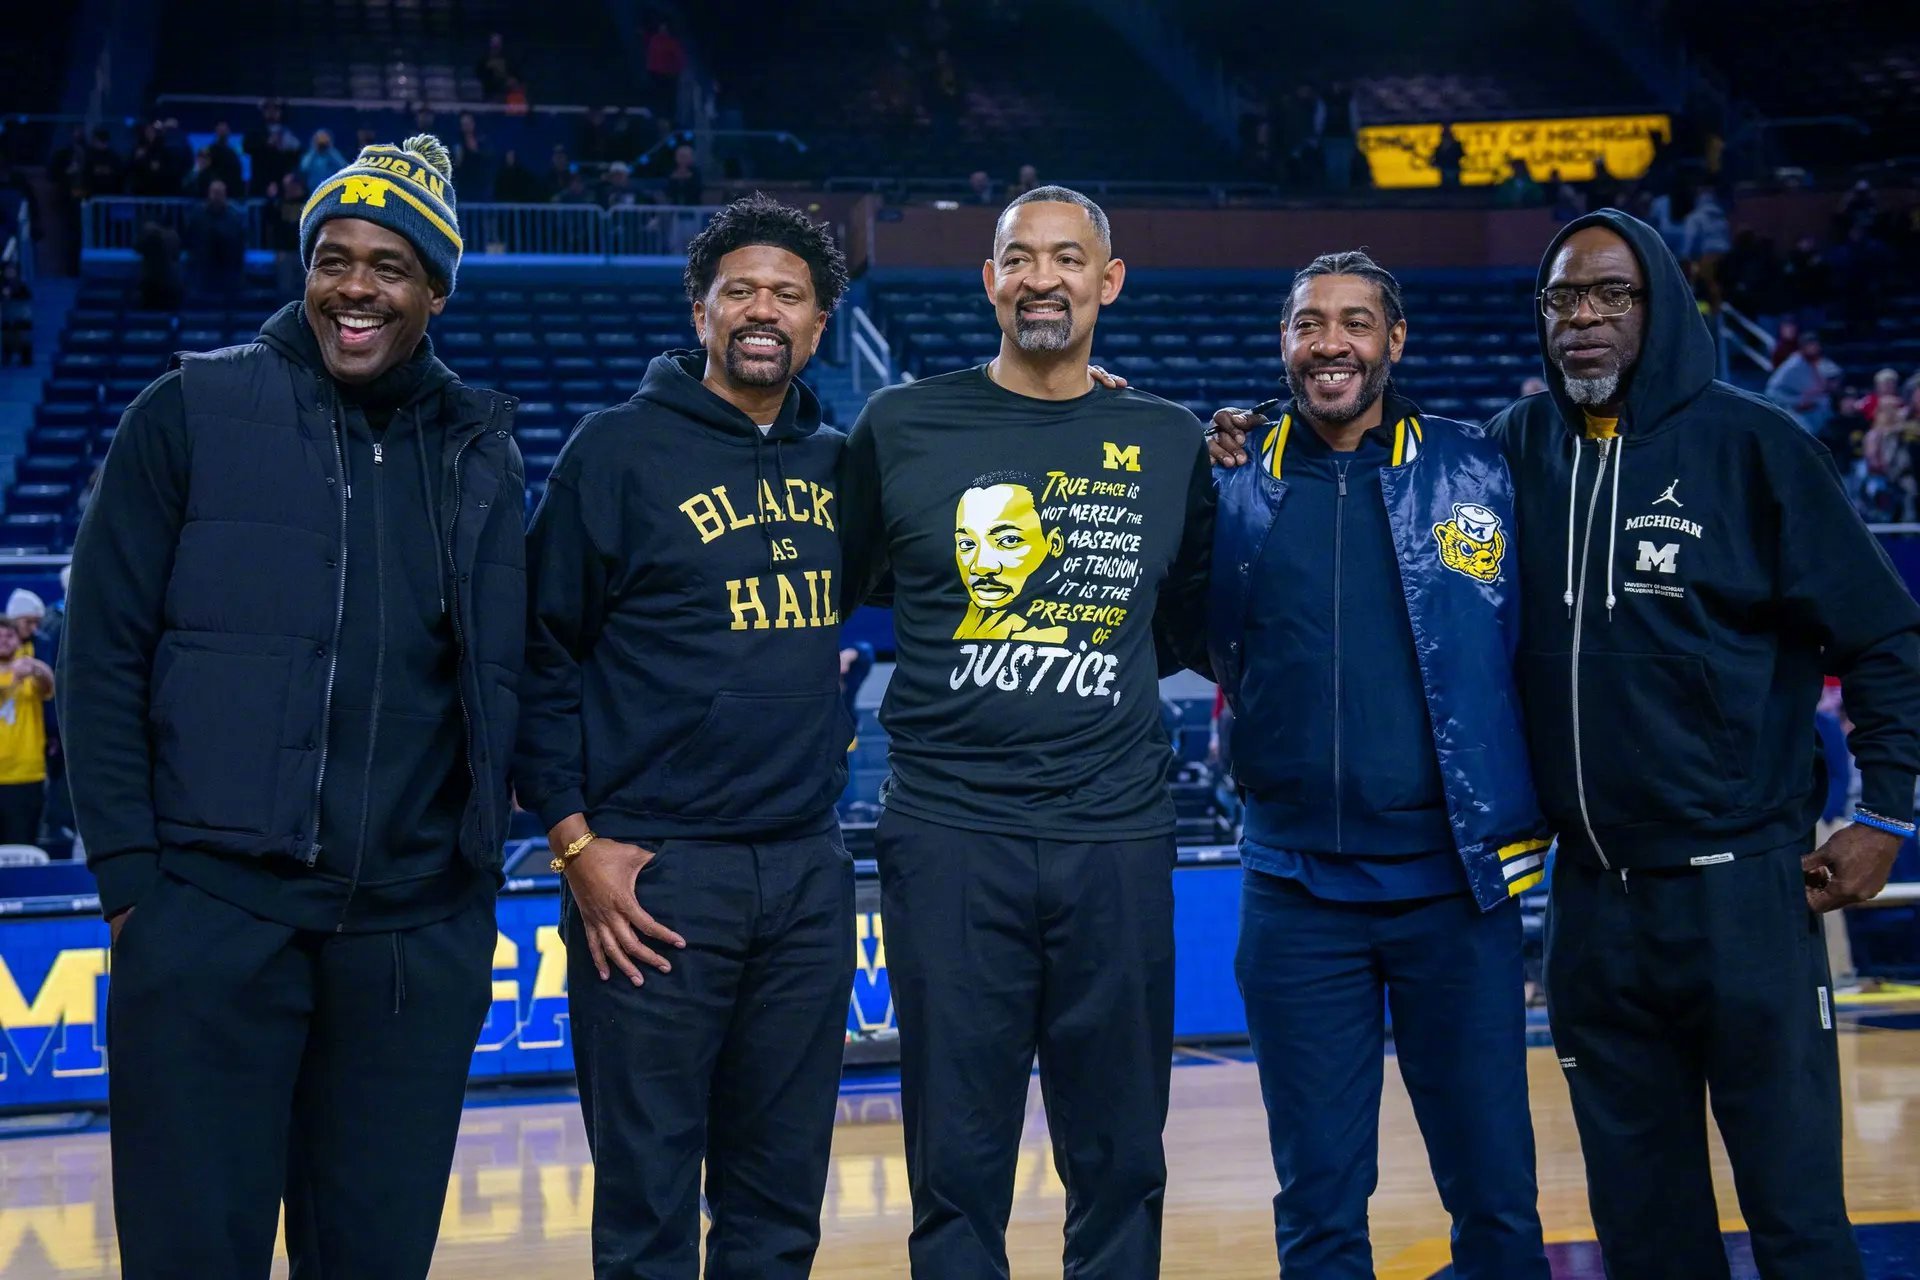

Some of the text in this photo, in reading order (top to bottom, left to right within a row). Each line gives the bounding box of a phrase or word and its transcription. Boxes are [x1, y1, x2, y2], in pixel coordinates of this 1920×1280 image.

[340, 178, 391, 208] M
[1103, 441, 1142, 472] M
[1041, 471, 1090, 503] TRUE
[1091, 481, 1126, 497] PEACE
[678, 478, 835, 544] BLACK
[1041, 503, 1143, 528] NOT MERELY THE
[1463, 519, 1486, 539] M
[1625, 515, 1703, 539] MICHIGAN
[771, 538, 798, 561] AS
[1067, 529, 1142, 552] ABSENCE
[1063, 557, 1082, 573] OF
[1635, 540, 1680, 574] M
[1057, 579, 1080, 596] IT
[1100, 586, 1132, 601] THE
[1624, 581, 1653, 589] UNIVERSITY
[1660, 585, 1685, 593] MICHIGAN
[1624, 586, 1654, 595] WOLVERINE
[726, 570, 836, 630] HAIL
[1026, 599, 1127, 626] PRESENCE
[1092, 627, 1112, 645] OF
